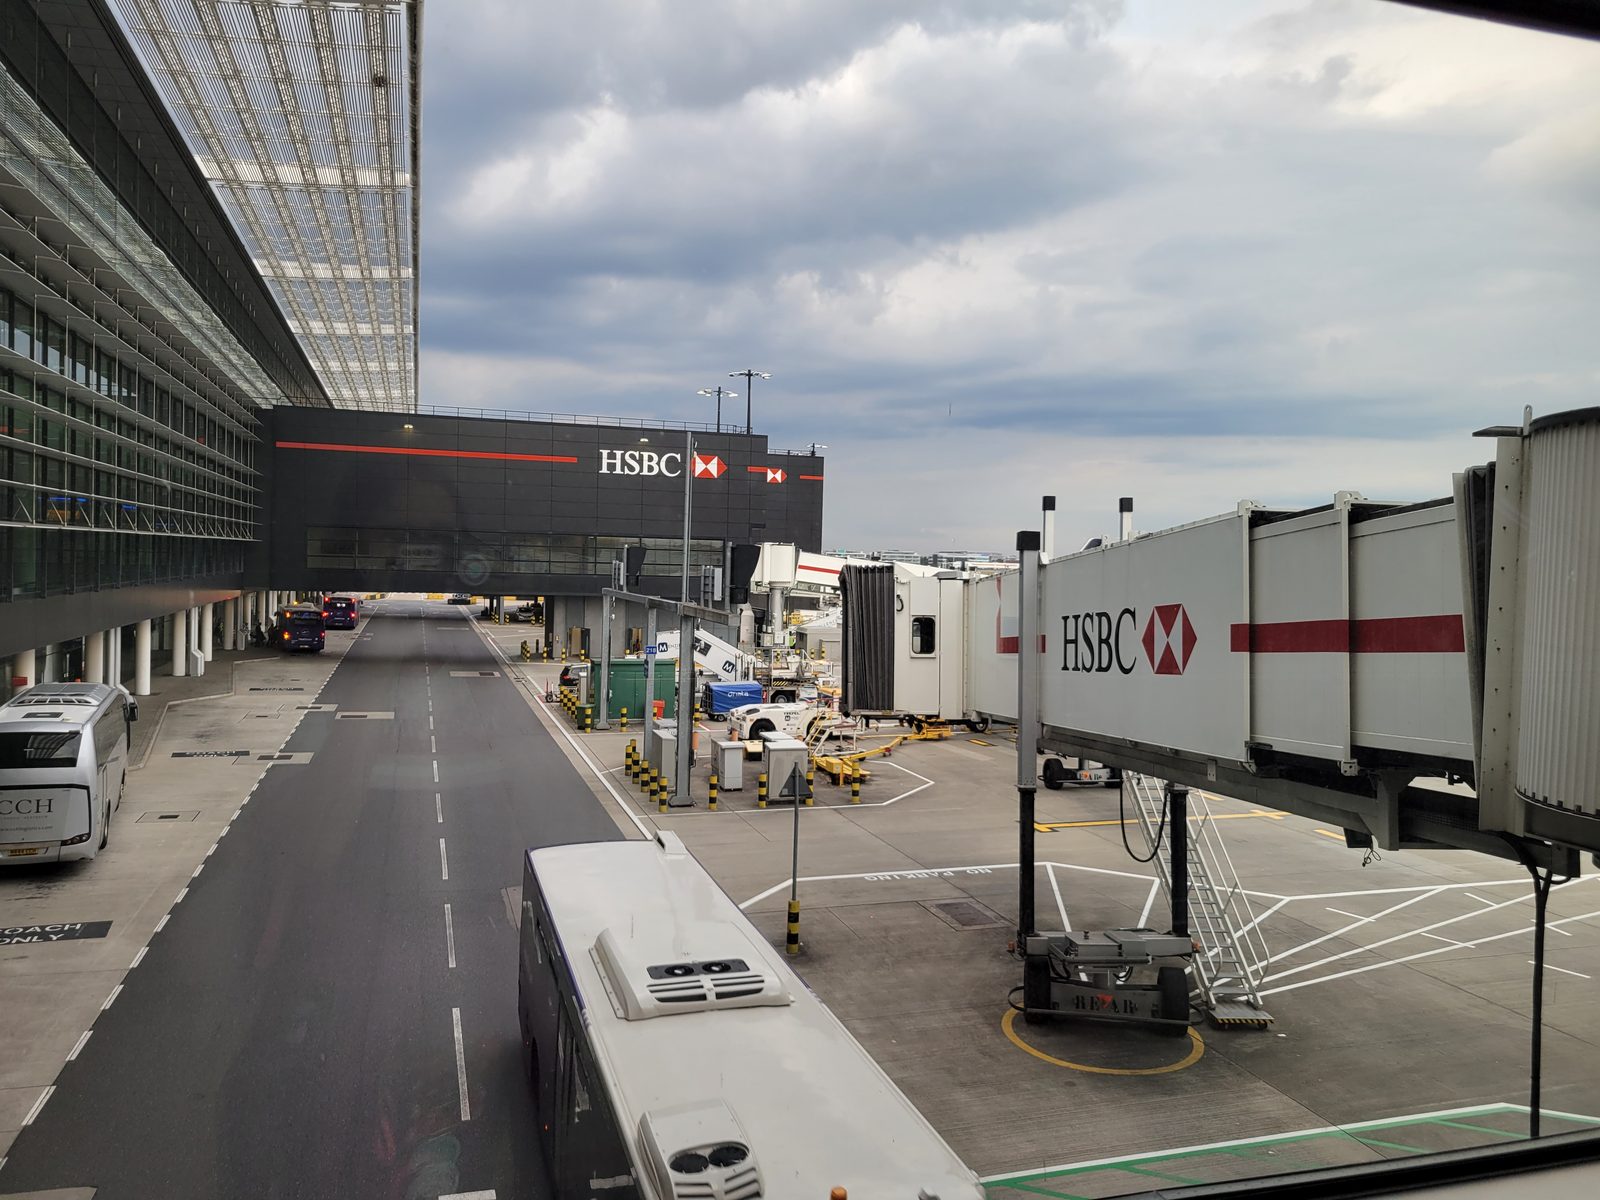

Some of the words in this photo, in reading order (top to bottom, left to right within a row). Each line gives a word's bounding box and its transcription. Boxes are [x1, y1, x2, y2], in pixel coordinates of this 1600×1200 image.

[599, 449, 681, 477] HSBC
[1061, 607, 1137, 675] HSBC
[863, 870, 955, 881] PARKING
[966, 867, 993, 875] NO
[0, 923, 82, 934] OACH
